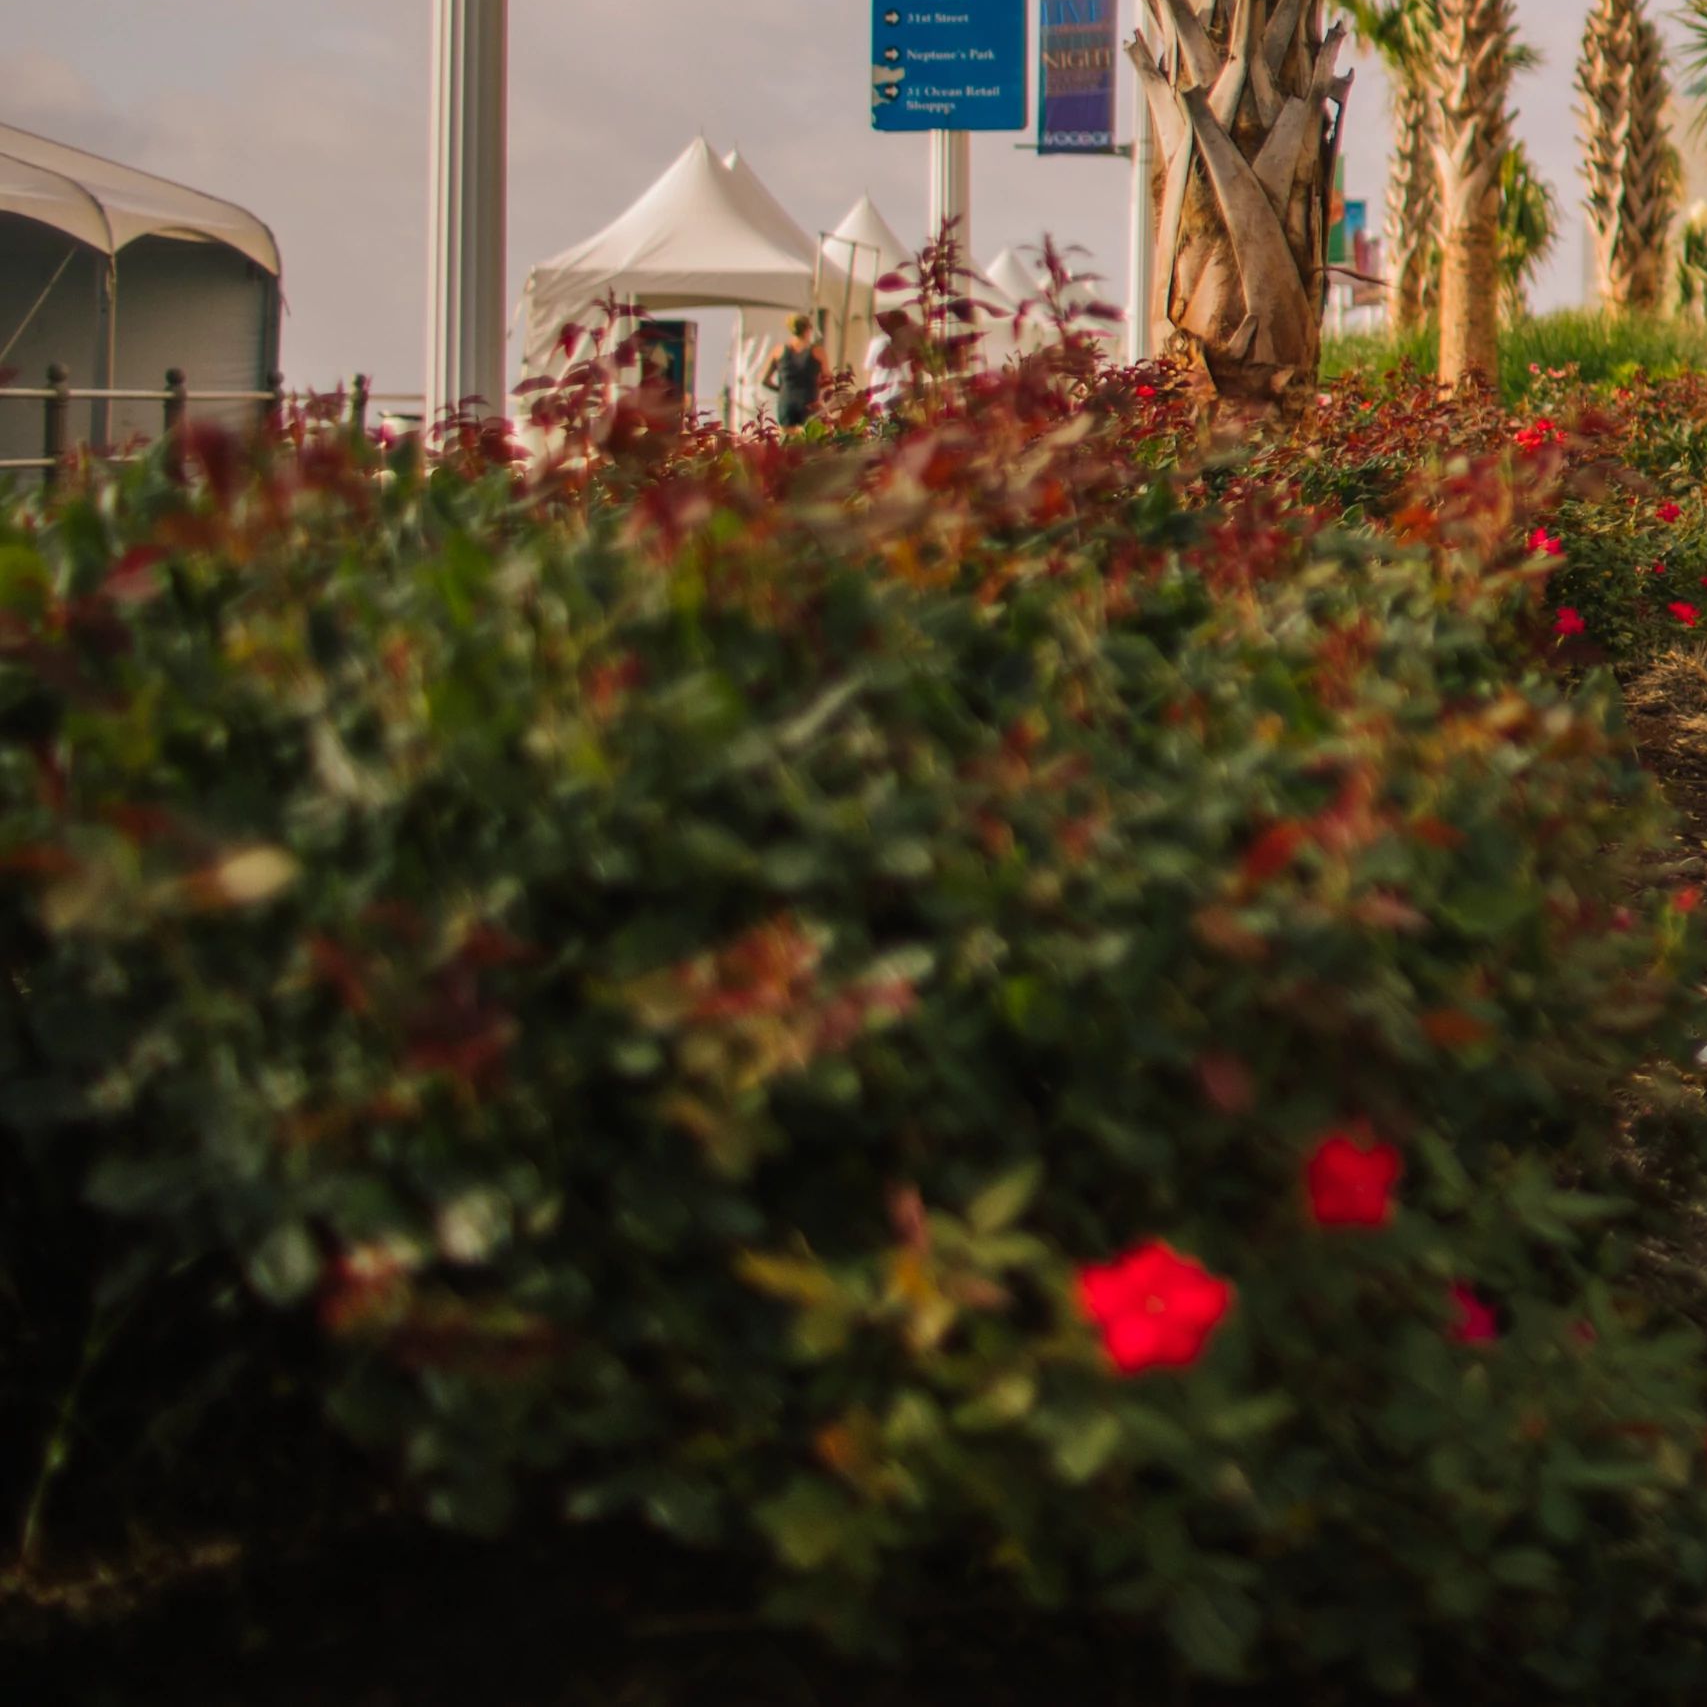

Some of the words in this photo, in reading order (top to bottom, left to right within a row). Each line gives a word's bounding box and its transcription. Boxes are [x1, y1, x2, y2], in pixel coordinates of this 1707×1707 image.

[935, 12, 969, 24] Street
[906, 48, 967, 62] Neptune's
[969, 47, 995, 60] Park
